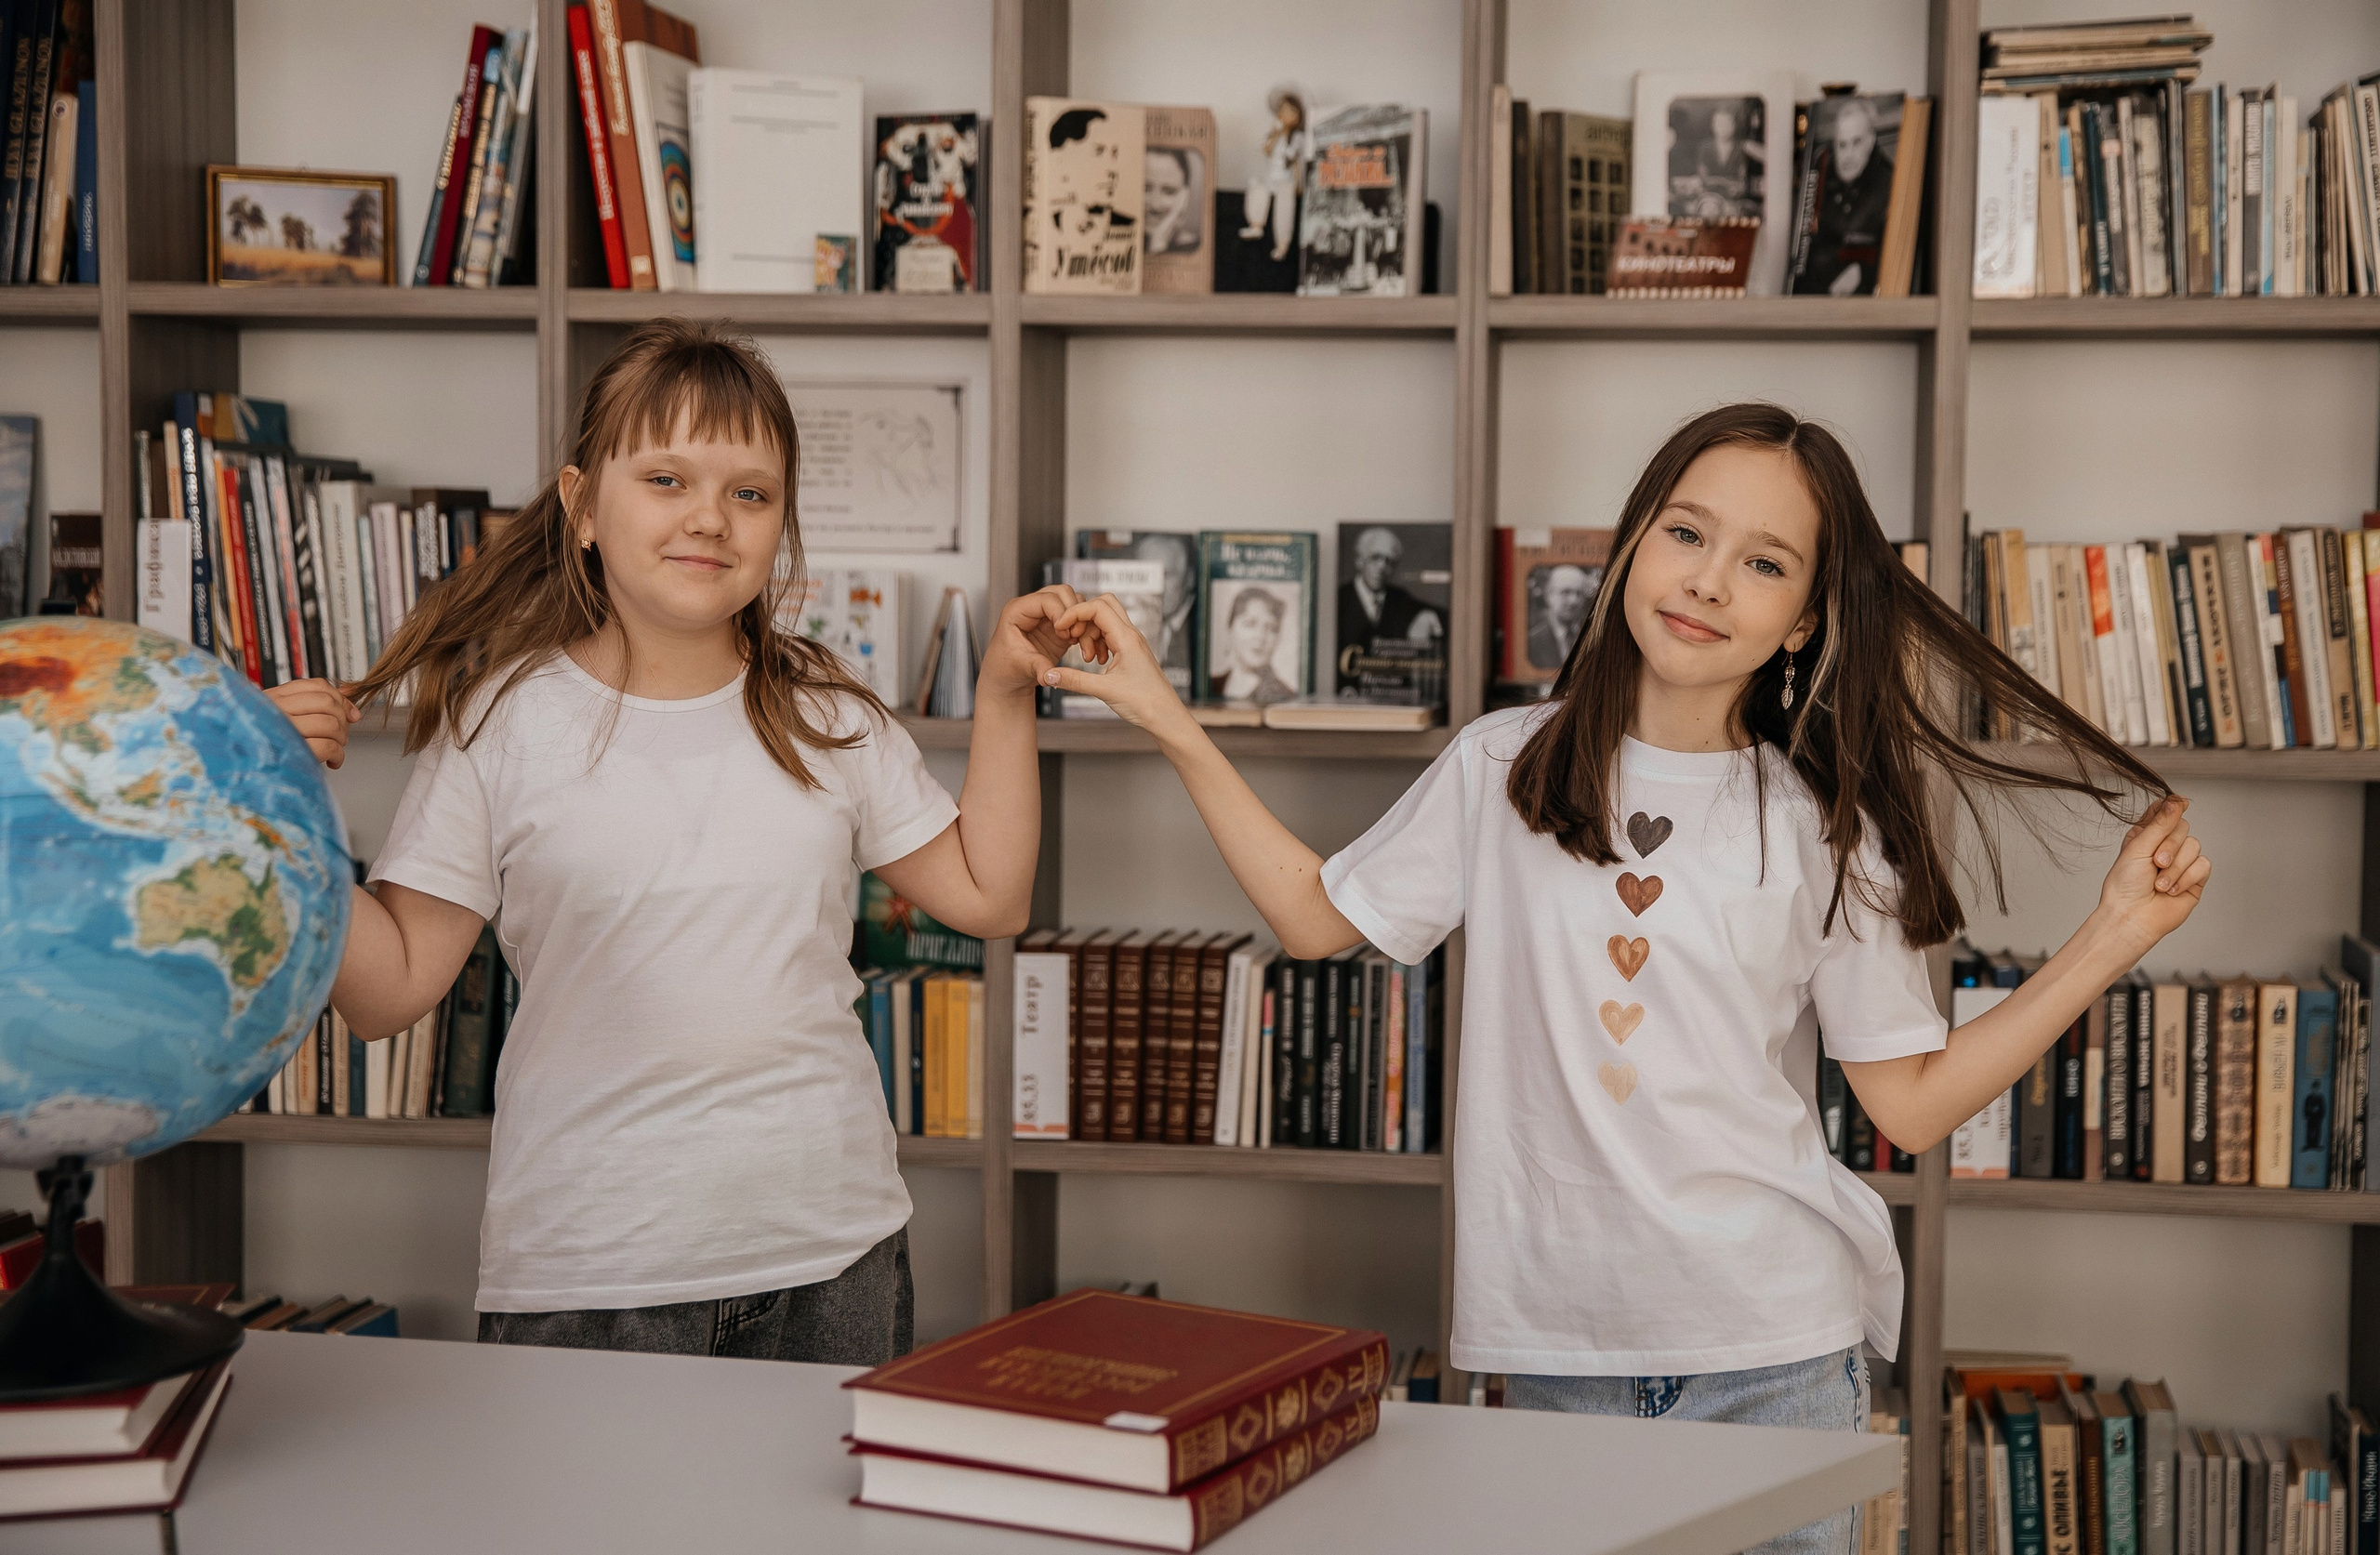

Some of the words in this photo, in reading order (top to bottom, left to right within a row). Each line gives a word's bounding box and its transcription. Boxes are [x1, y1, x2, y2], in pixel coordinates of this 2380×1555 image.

[1051, 243, 1135, 279] Утёсов
[1617, 256, 1736, 273] КИНОТЕАТРЫ
[145, 519, 163, 613] Графика
[1020, 975, 1043, 1036] Театр
[2190, 992, 2209, 1060] Феллини
[1021, 1074, 1038, 1122] 85.33
[2066, 1058, 2080, 1098] КИНО
[2190, 1074, 2209, 1142] Феллини
[2049, 1469, 2071, 1538] ОЛИВЬЕ
